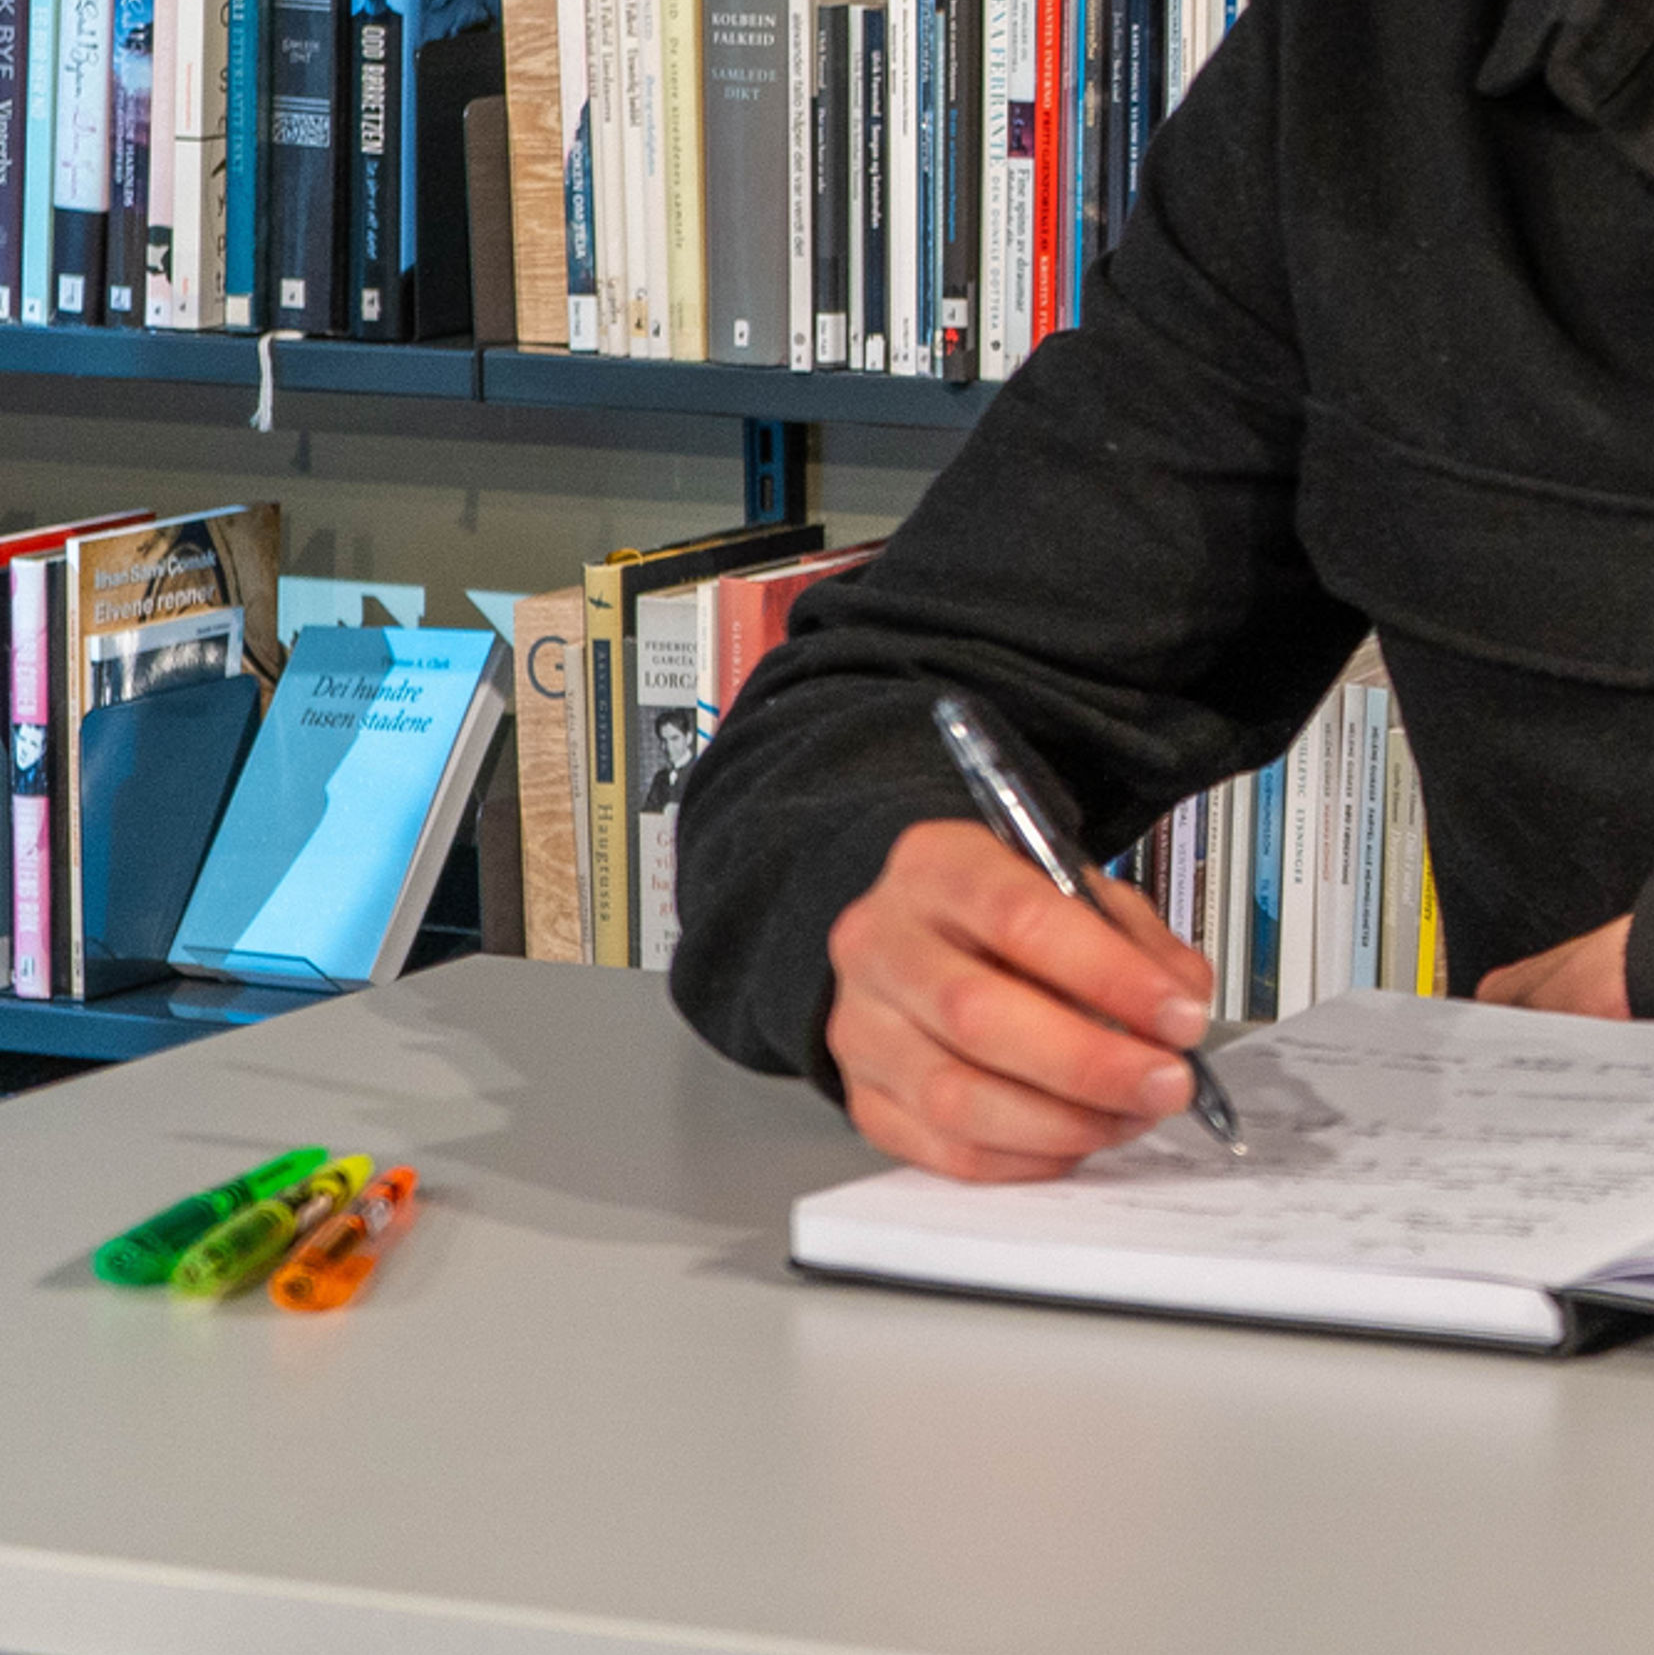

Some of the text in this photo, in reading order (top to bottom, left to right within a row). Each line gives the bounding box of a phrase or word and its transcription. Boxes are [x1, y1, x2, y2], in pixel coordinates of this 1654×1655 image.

[712, 12, 777, 29] KOLBEIN
[0, 23, 17, 79] BYE
[713, 30, 775, 47] FALKEID
[790, 12, 805, 77] alexander
[711, 66, 778, 83] SAMLEDE
[723, 86, 762, 102] DIKT
[988, 46, 1008, 168] FERRANTE
[788, 111, 806, 149] håper
[793, 151, 806, 173] det
[793, 176, 804, 197] var
[793, 200, 806, 234] verdt
[793, 236, 806, 257] det
[1013, 168, 1031, 313] Fine spinn av draumar
[94, 588, 216, 627] Elvene renner
[311, 676, 425, 704] Dei hundre
[357, 708, 434, 734] stadene
[595, 803, 613, 923] Haugtussa
